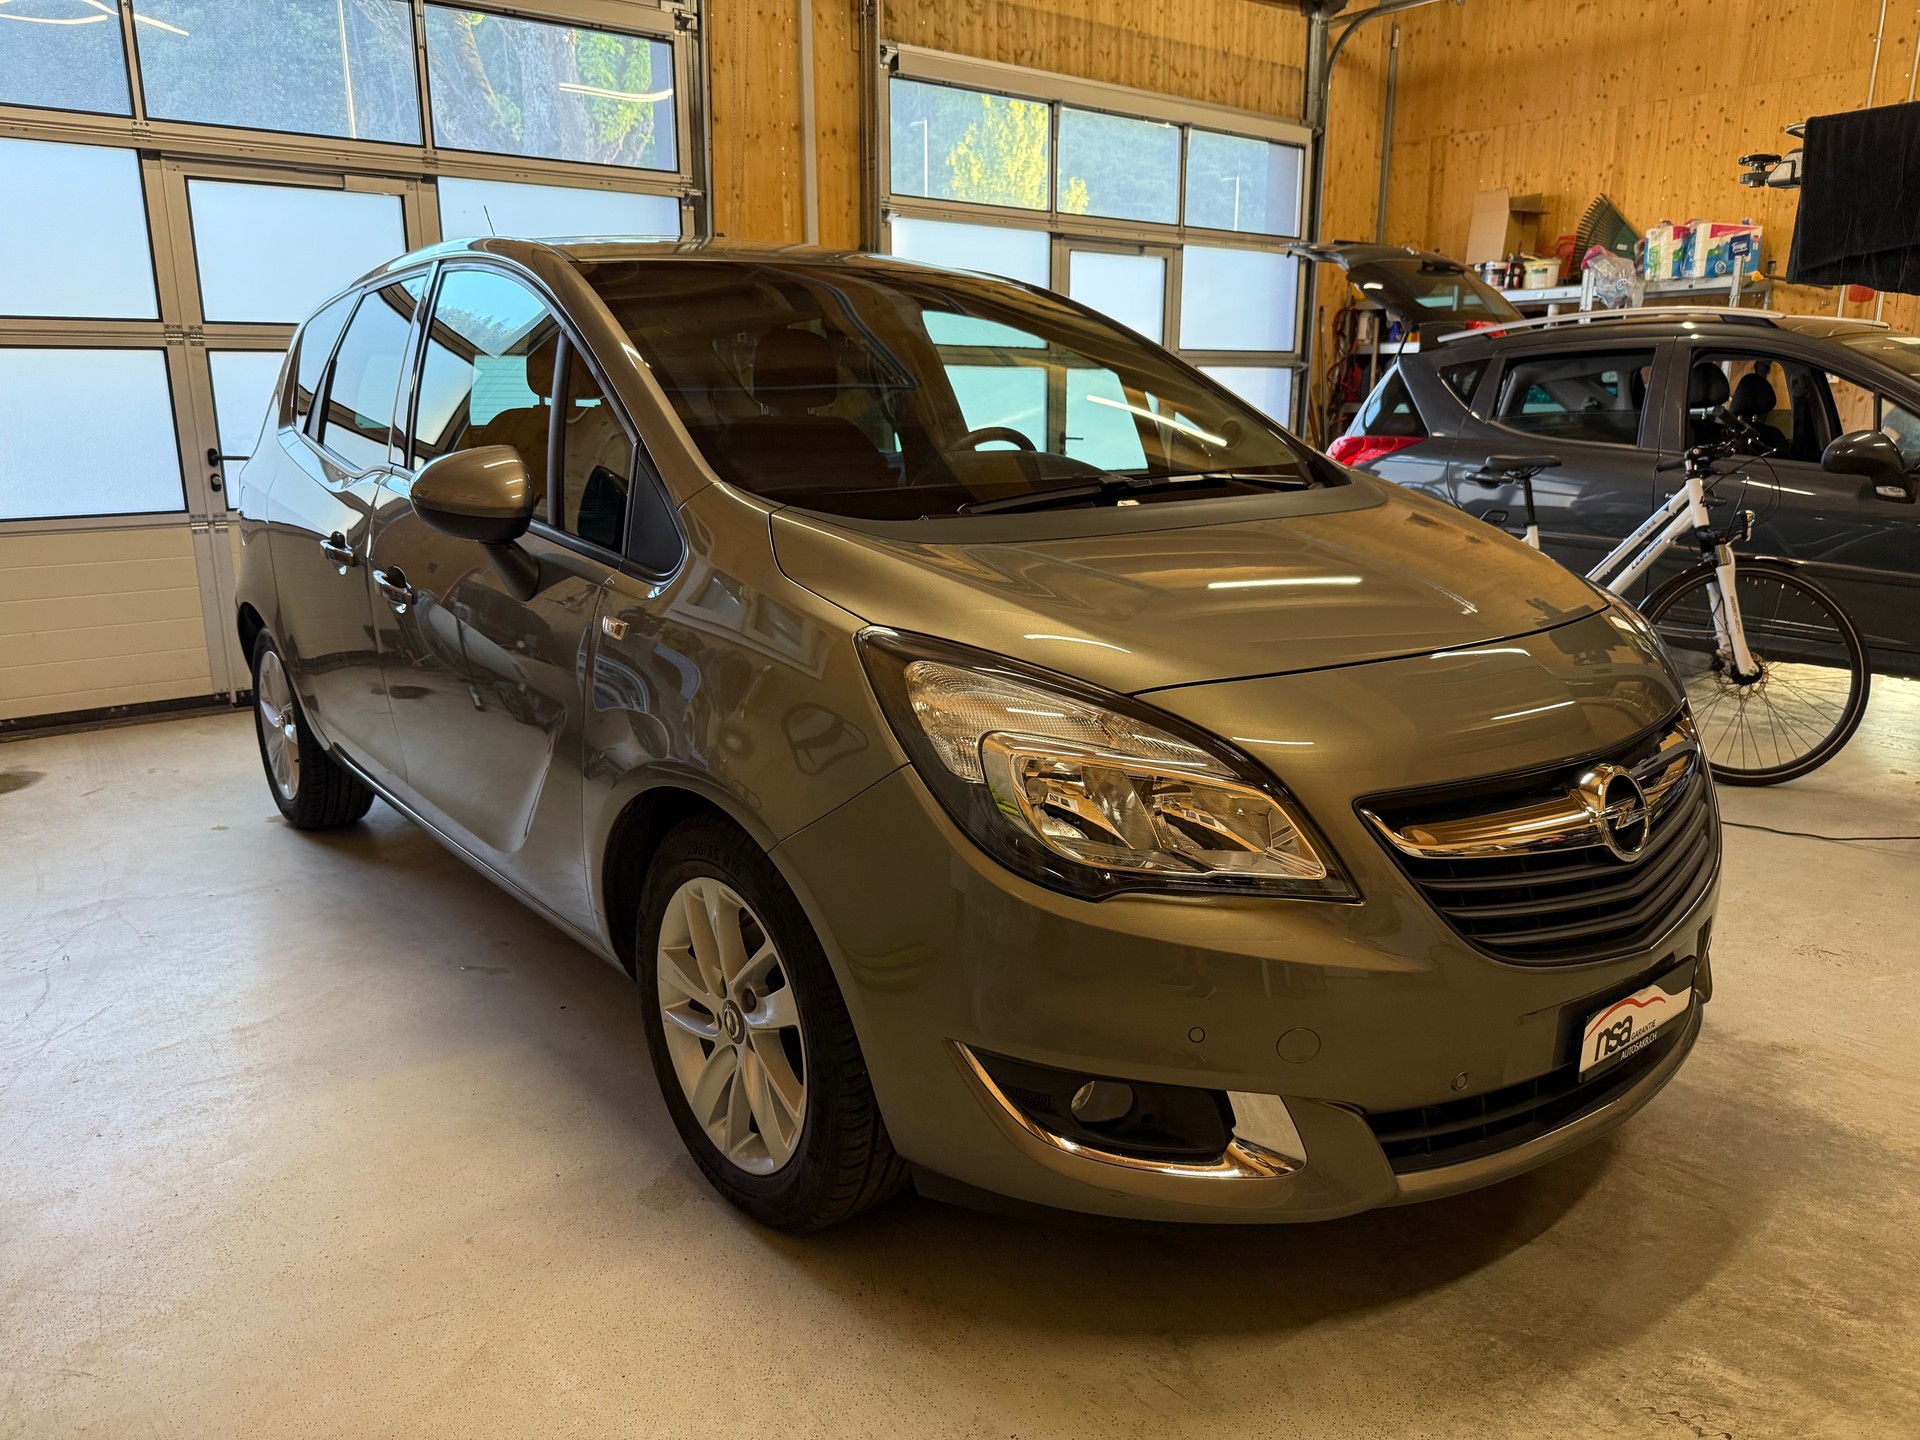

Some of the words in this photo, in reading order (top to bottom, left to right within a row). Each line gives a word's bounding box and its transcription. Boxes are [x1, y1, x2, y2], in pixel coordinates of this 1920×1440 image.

[687, 840, 720, 861] 205/55
[723, 853, 741, 877] R16
[1594, 1014, 1633, 1062] nsa
[1630, 1019, 1657, 1040] GARANTIE
